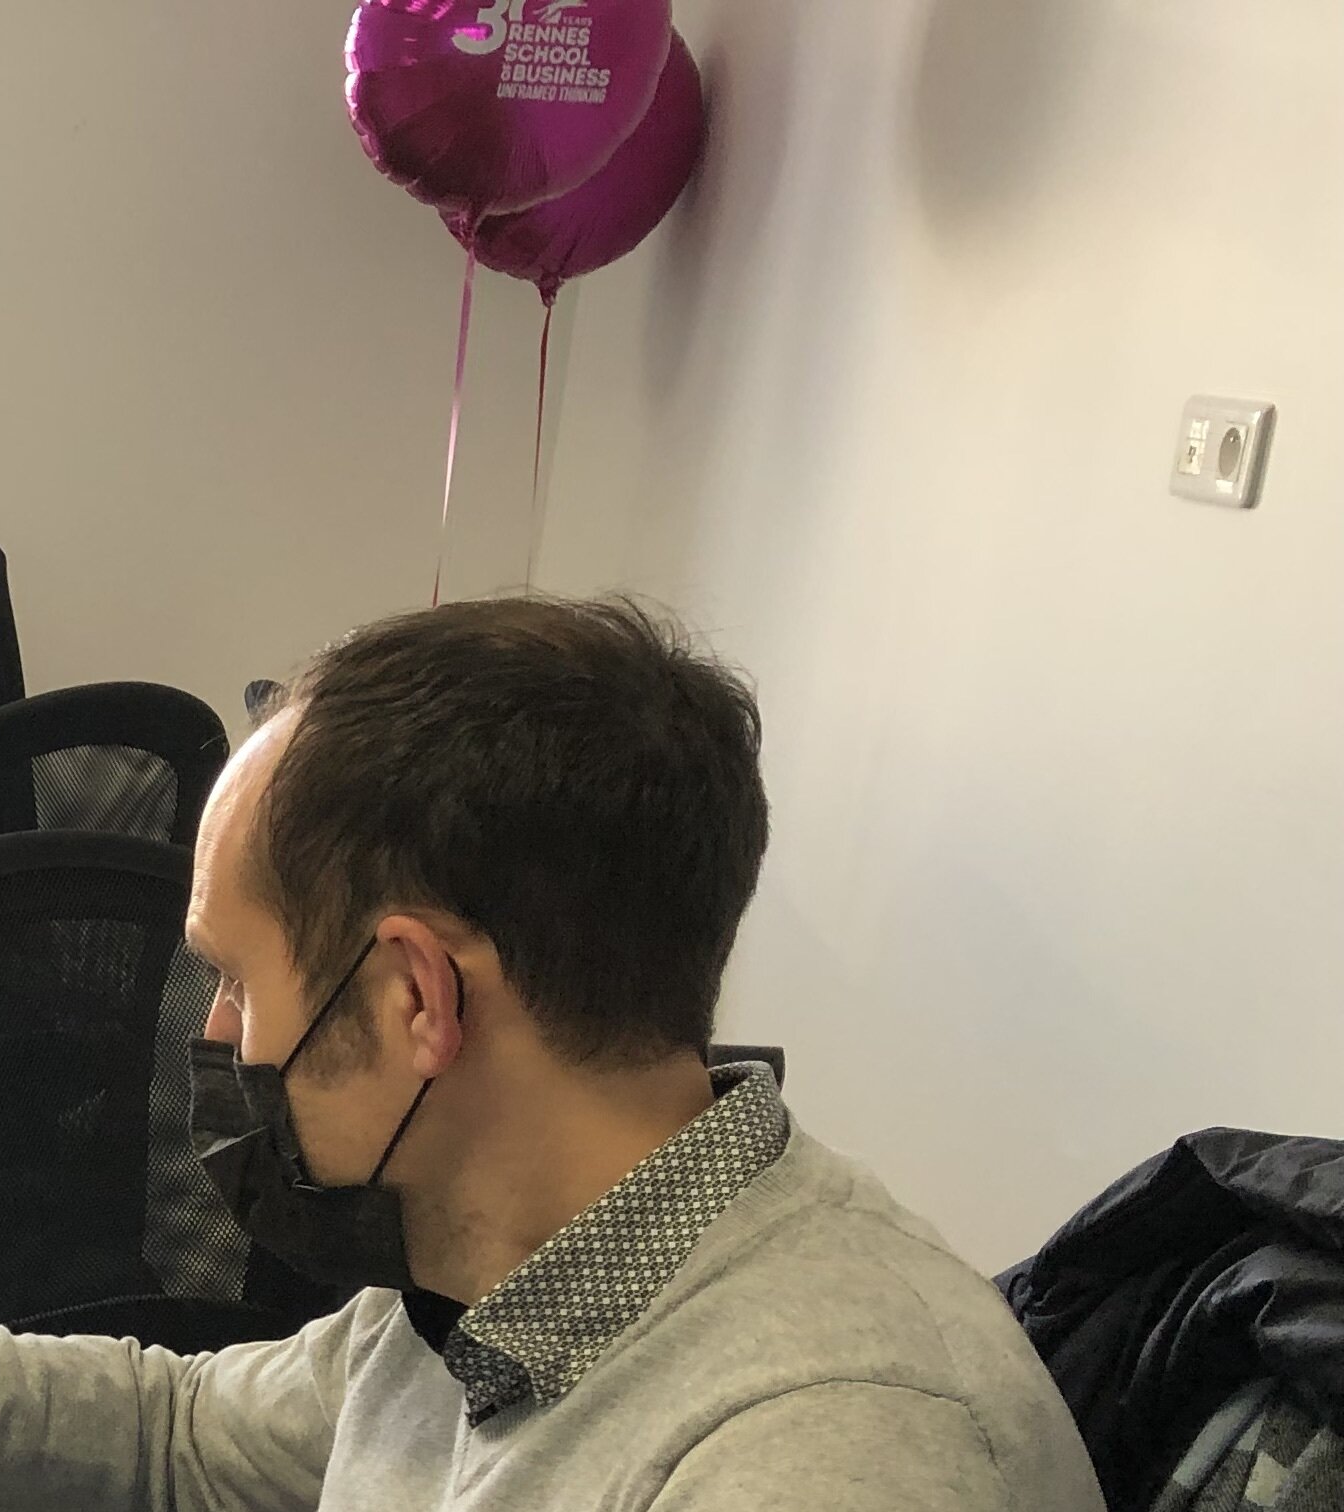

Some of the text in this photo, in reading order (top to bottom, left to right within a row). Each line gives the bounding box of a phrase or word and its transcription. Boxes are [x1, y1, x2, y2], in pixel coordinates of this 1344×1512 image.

[509, 23, 591, 47] RENNES
[504, 43, 592, 66] SCHOOL
[512, 63, 611, 87] BUSINESS
